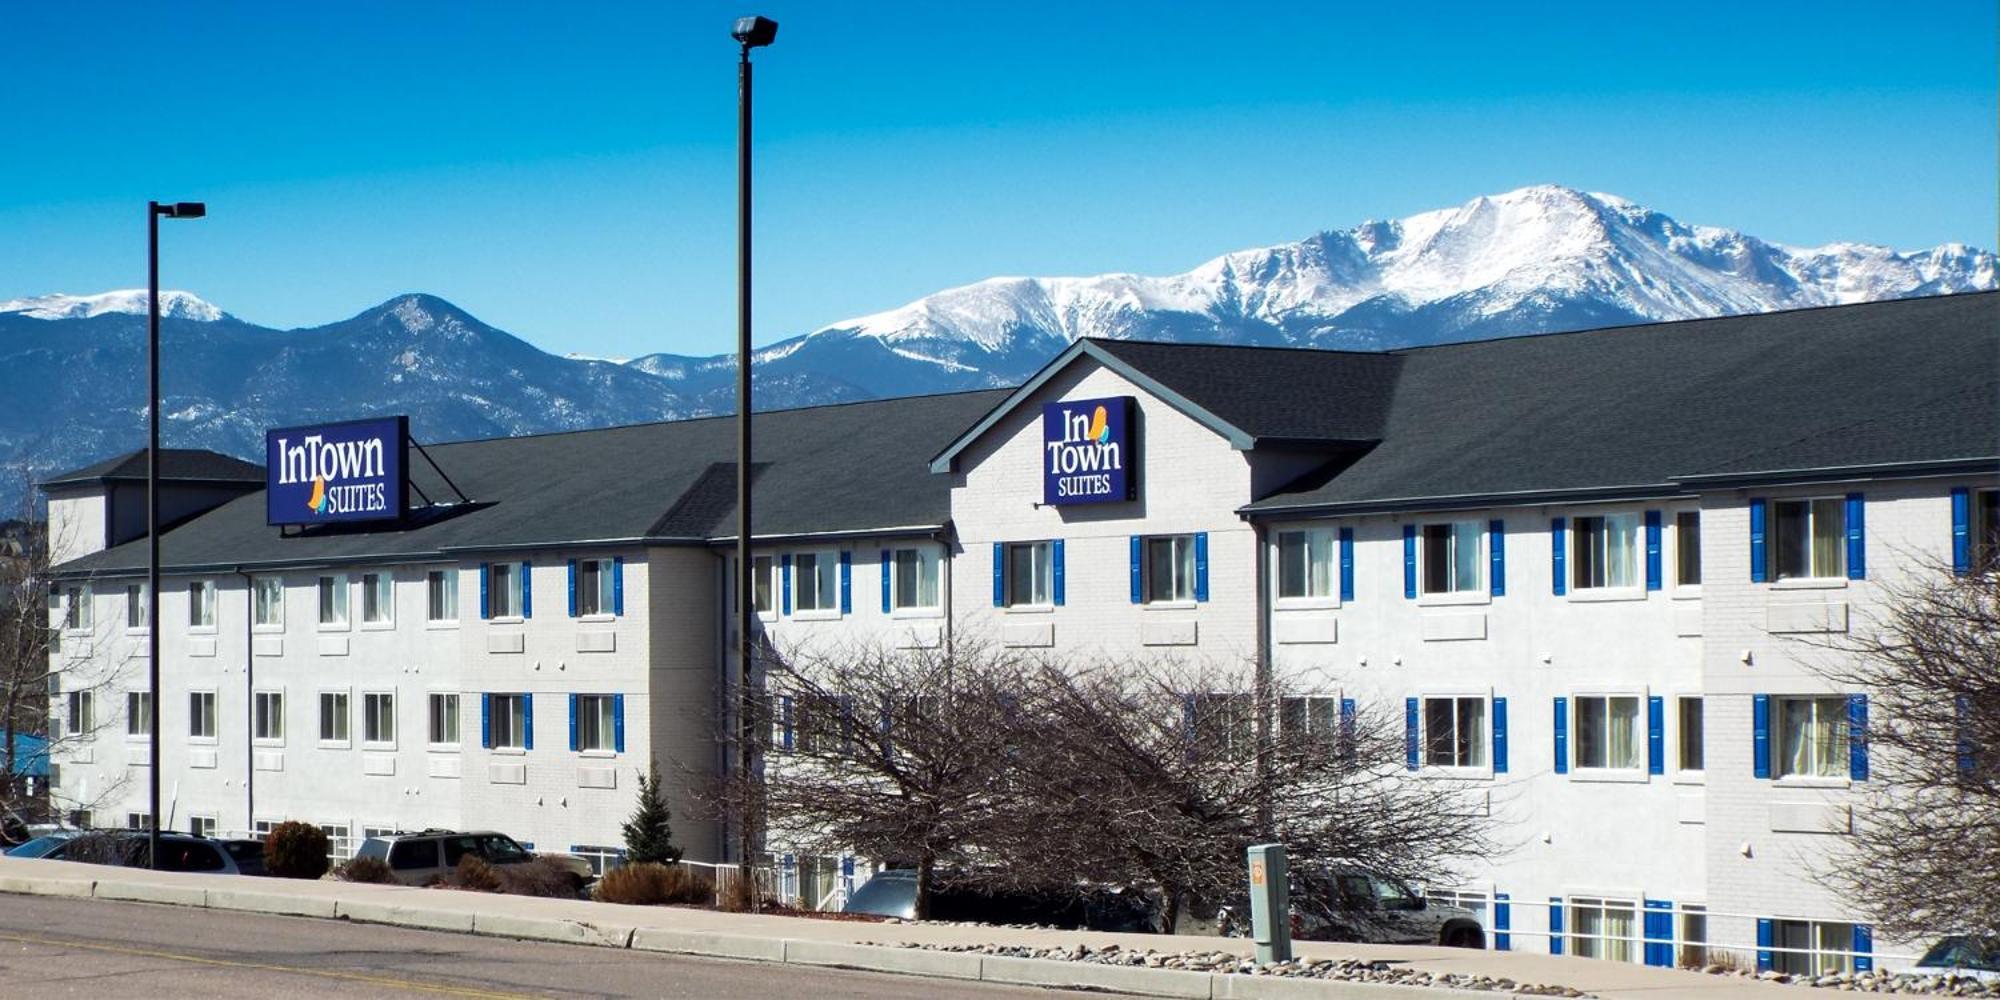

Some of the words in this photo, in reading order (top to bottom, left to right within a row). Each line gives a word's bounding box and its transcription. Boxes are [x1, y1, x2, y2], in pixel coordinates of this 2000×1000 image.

[1063, 410, 1091, 443] In
[278, 435, 384, 484] InTown
[1047, 441, 1121, 474] Town
